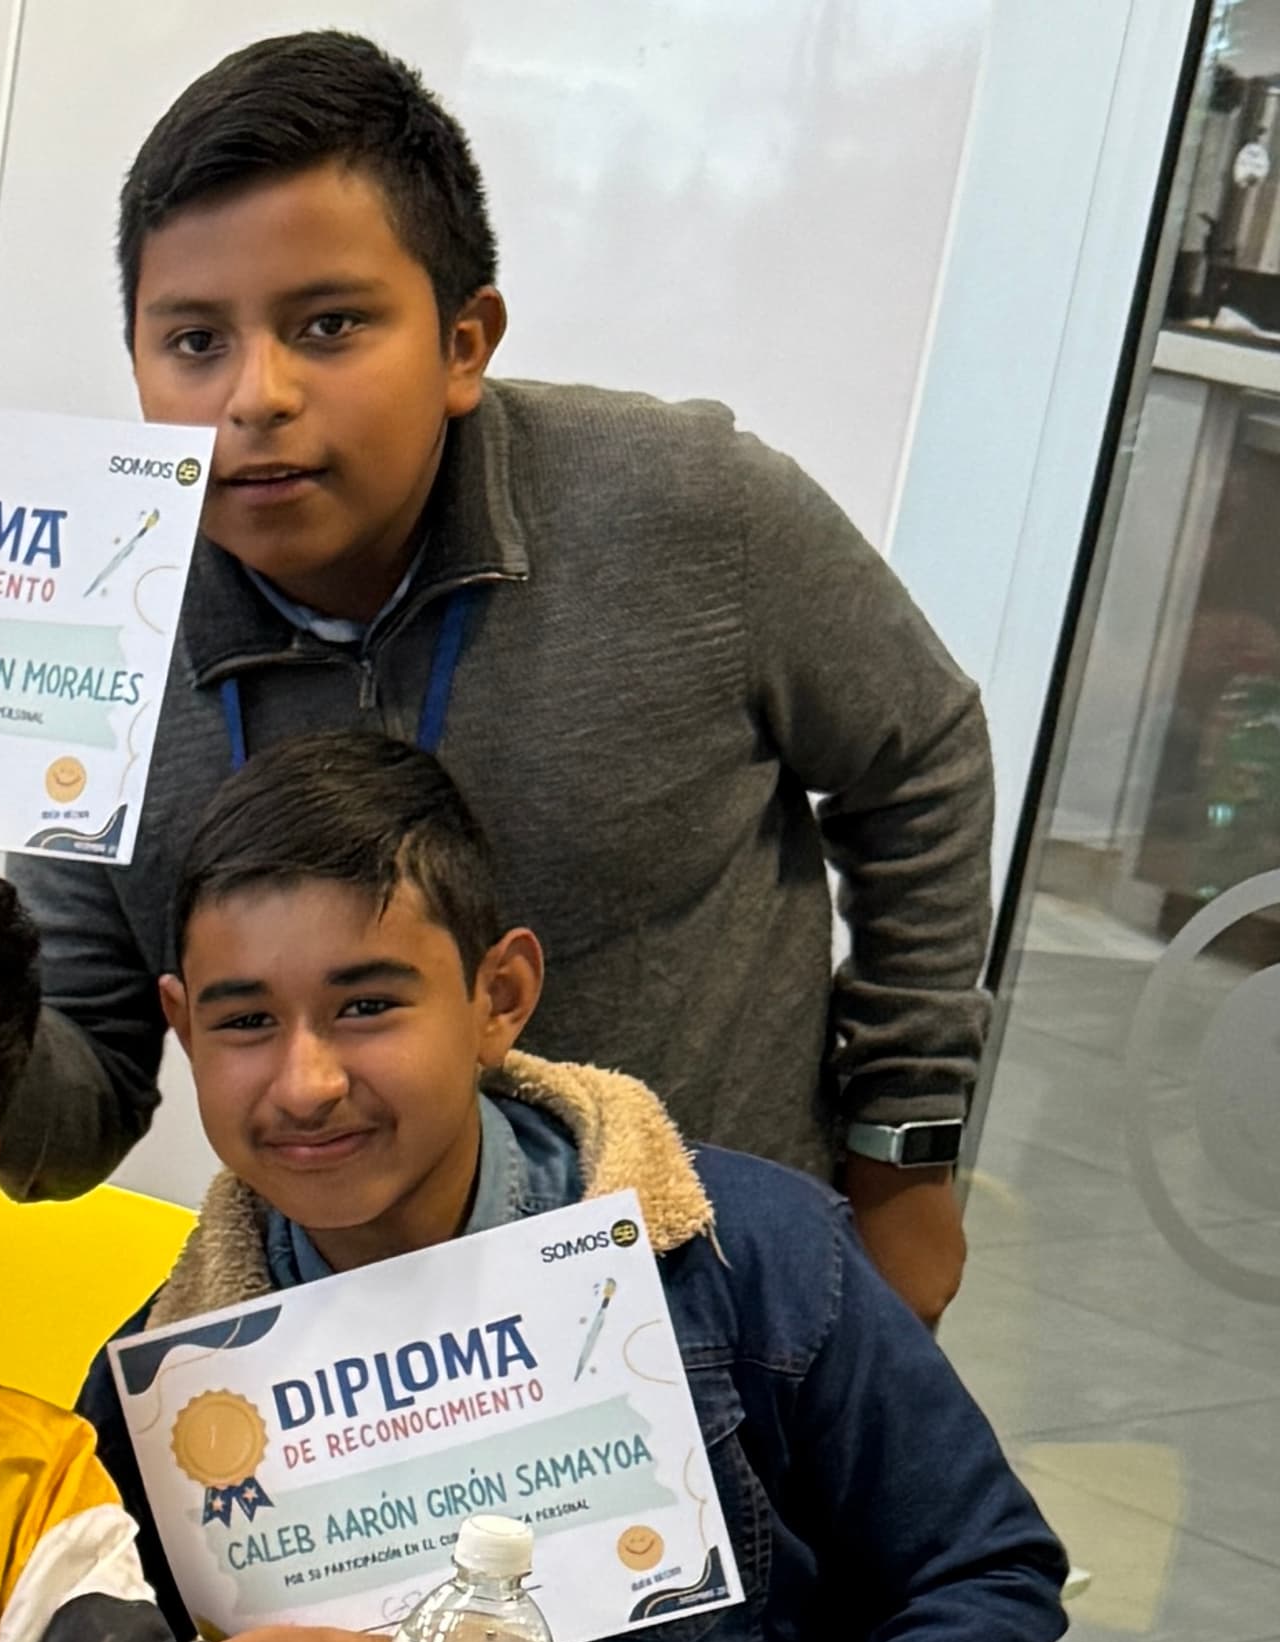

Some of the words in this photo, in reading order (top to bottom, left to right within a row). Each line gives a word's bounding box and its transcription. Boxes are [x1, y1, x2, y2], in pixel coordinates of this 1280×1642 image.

[109, 456, 174, 479] SOMOS
[22, 661, 144, 706] MORALES
[541, 1230, 610, 1263] SOMOS
[271, 1313, 538, 1430] DIPLOMA
[283, 1441, 316, 1469] DE
[328, 1379, 545, 1457] RECONOCIMIENTO
[227, 1523, 316, 1571] CALEB
[326, 1490, 418, 1545] AARÓN
[427, 1468, 507, 1519] GIRÓN
[517, 1434, 653, 1497] SAMAYOA
[284, 1573, 305, 1587] POR
[308, 1569, 322, 1581] SU
[405, 1542, 419, 1556] EN
[422, 1538, 436, 1552] EL
